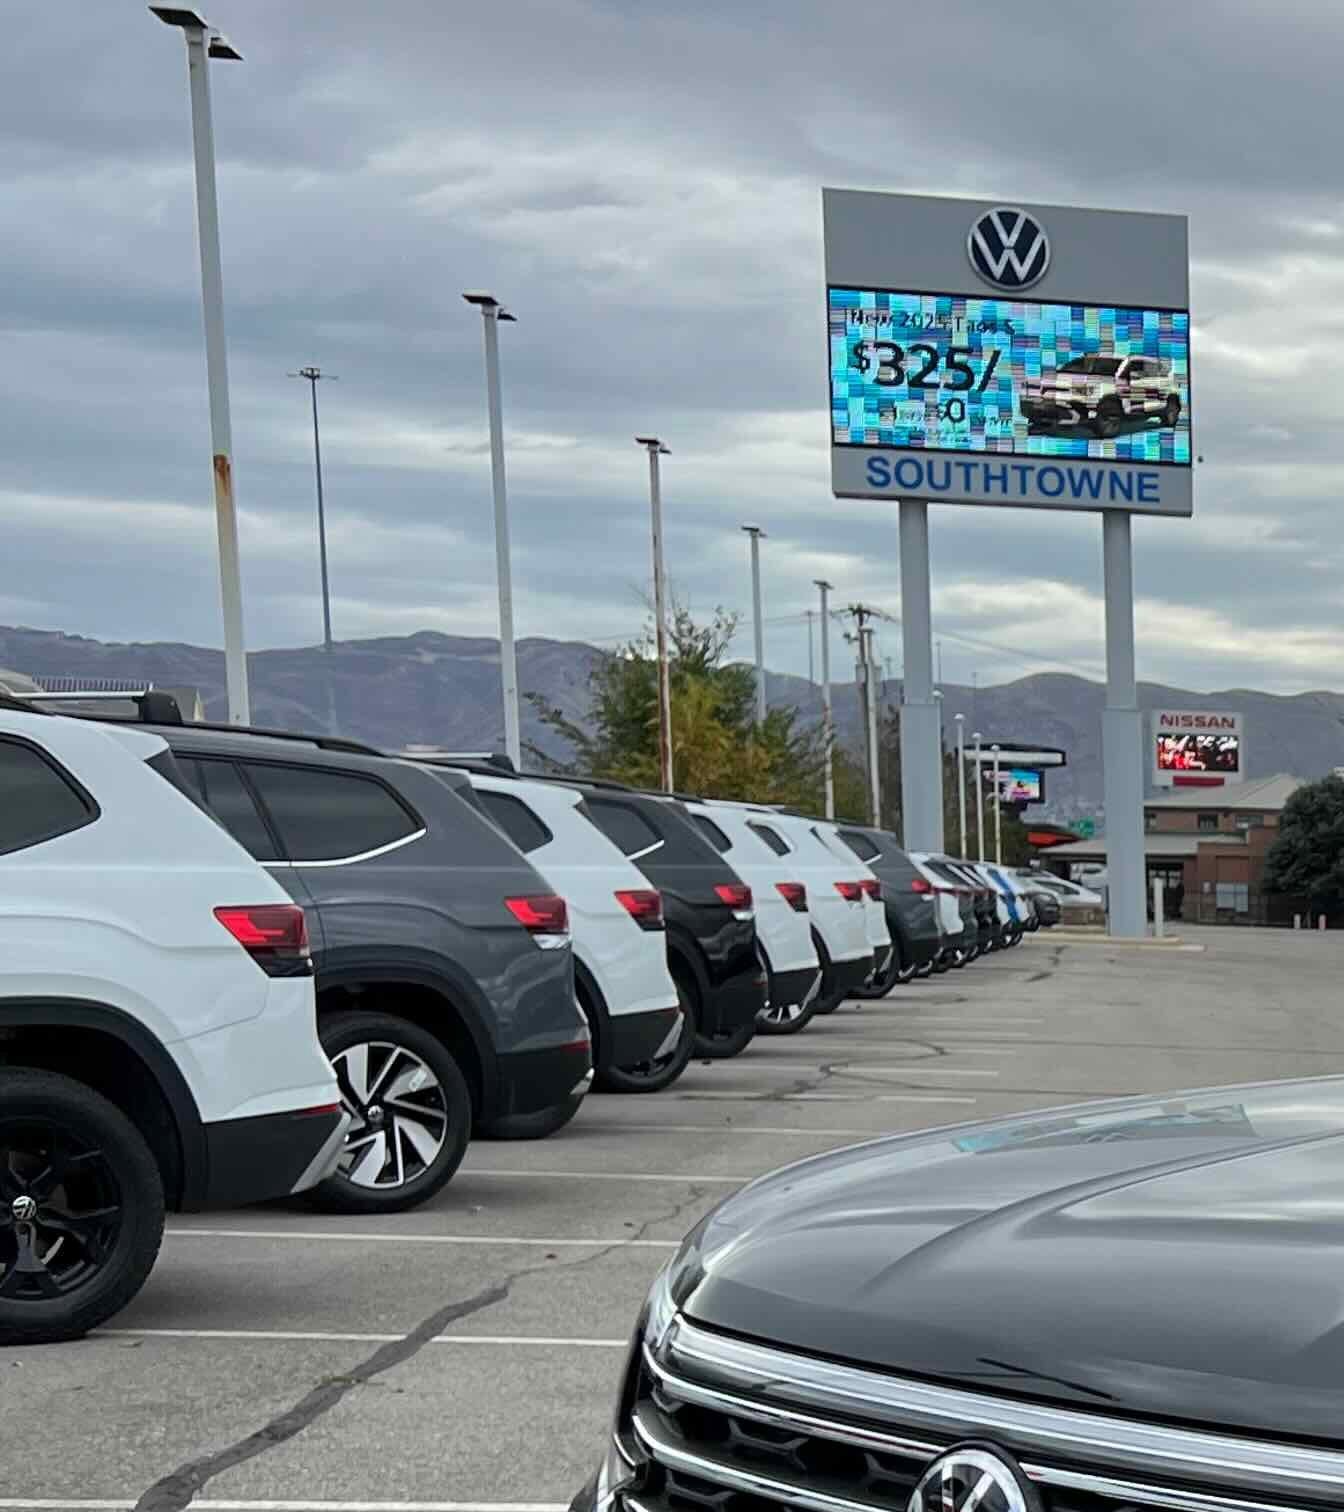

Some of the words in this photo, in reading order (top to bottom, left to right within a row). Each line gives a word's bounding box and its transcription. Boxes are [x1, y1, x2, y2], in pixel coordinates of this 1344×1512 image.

[970, 209, 1048, 287] VW
[852, 340, 1001, 392] $325/
[865, 455, 1161, 503] SOUTHTOWNE
[1160, 713, 1235, 729] NISSAN
